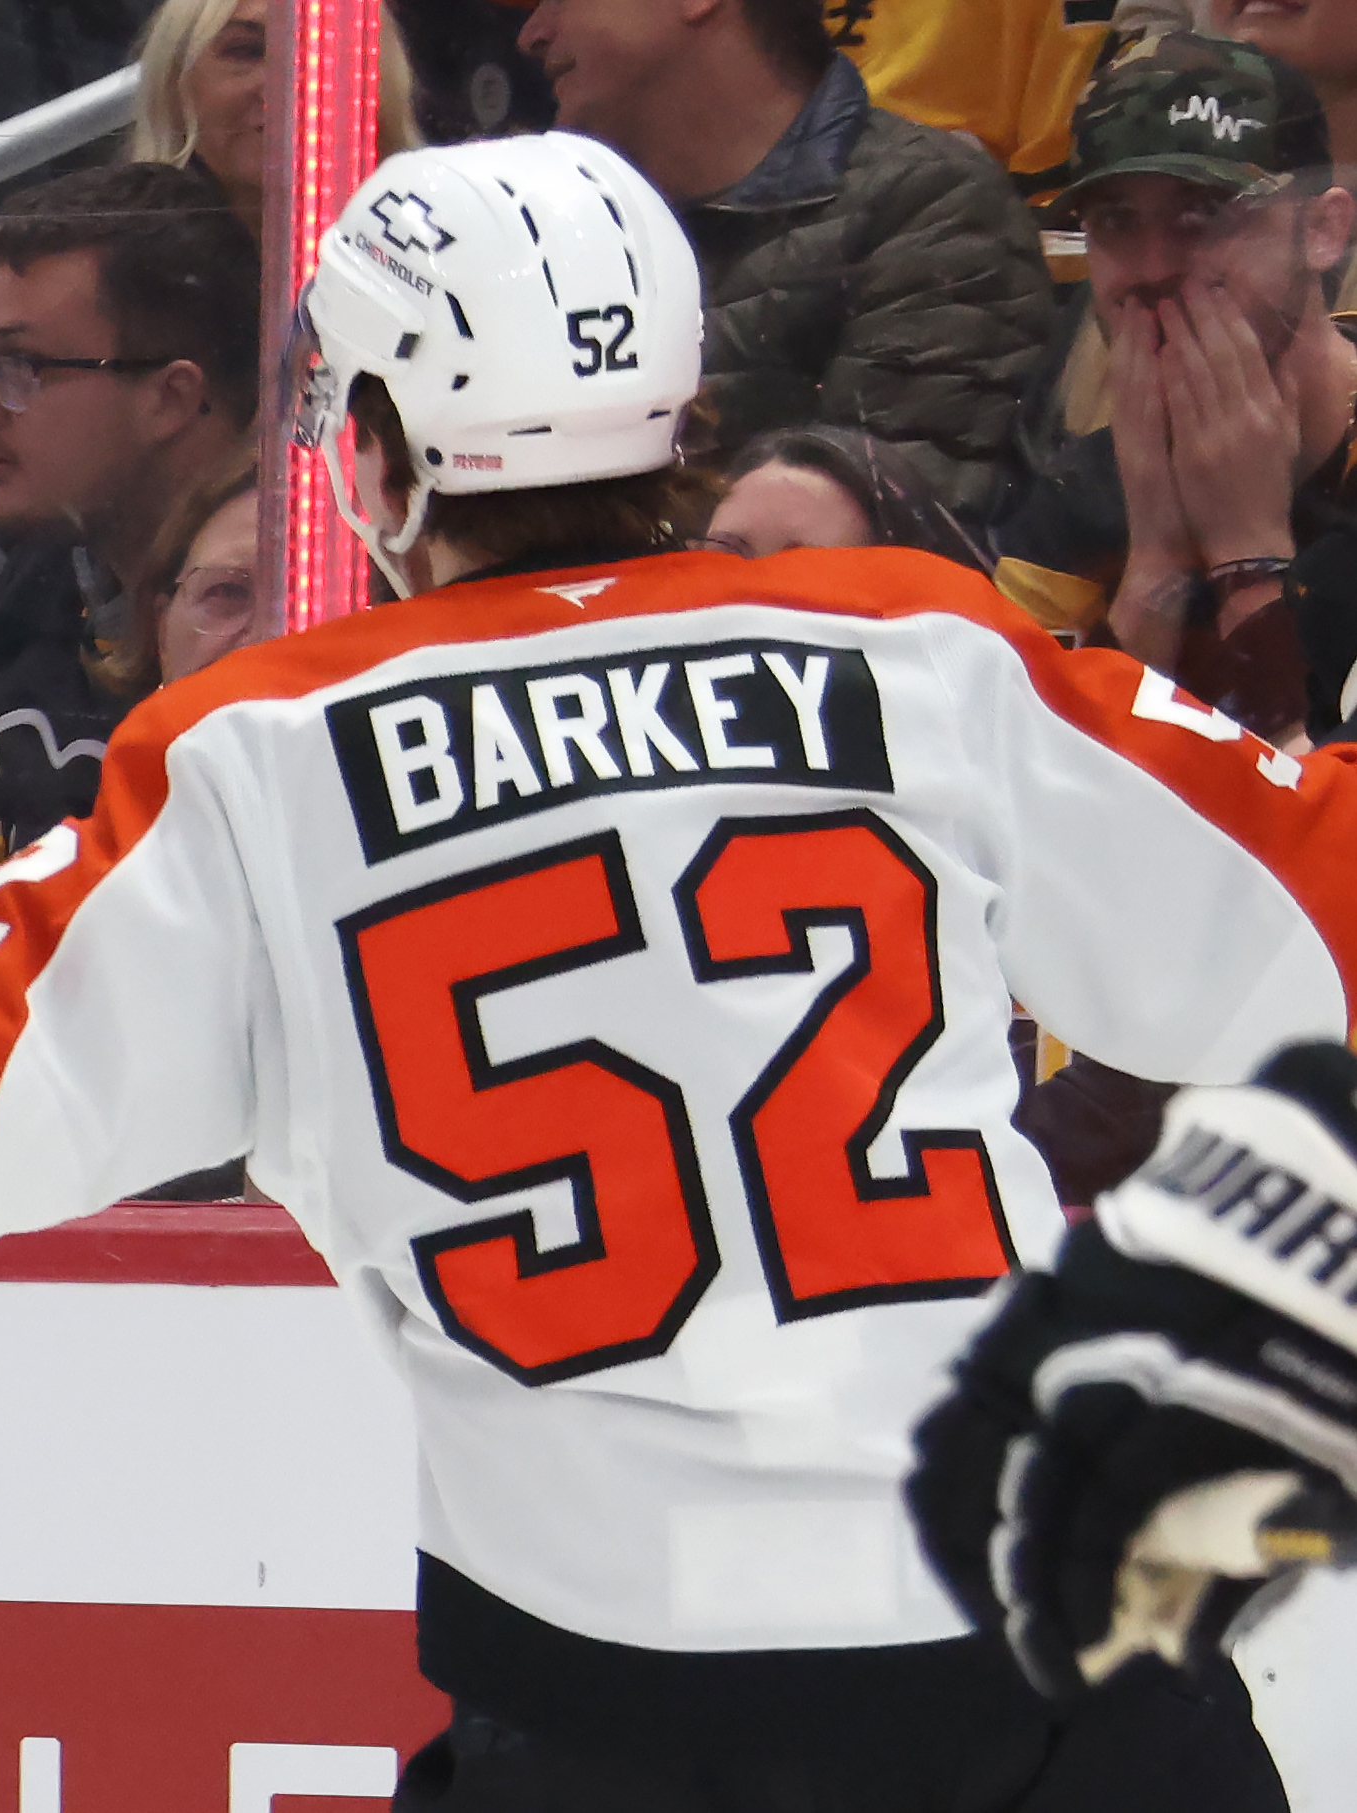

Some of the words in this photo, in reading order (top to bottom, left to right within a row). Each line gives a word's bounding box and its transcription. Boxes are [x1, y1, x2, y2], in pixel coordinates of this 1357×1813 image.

[355, 231, 435, 298] CHEVROLET
[565, 304, 639, 378] 52
[367, 650, 835, 837] BARKEY
[333, 806, 1023, 1389] 52
